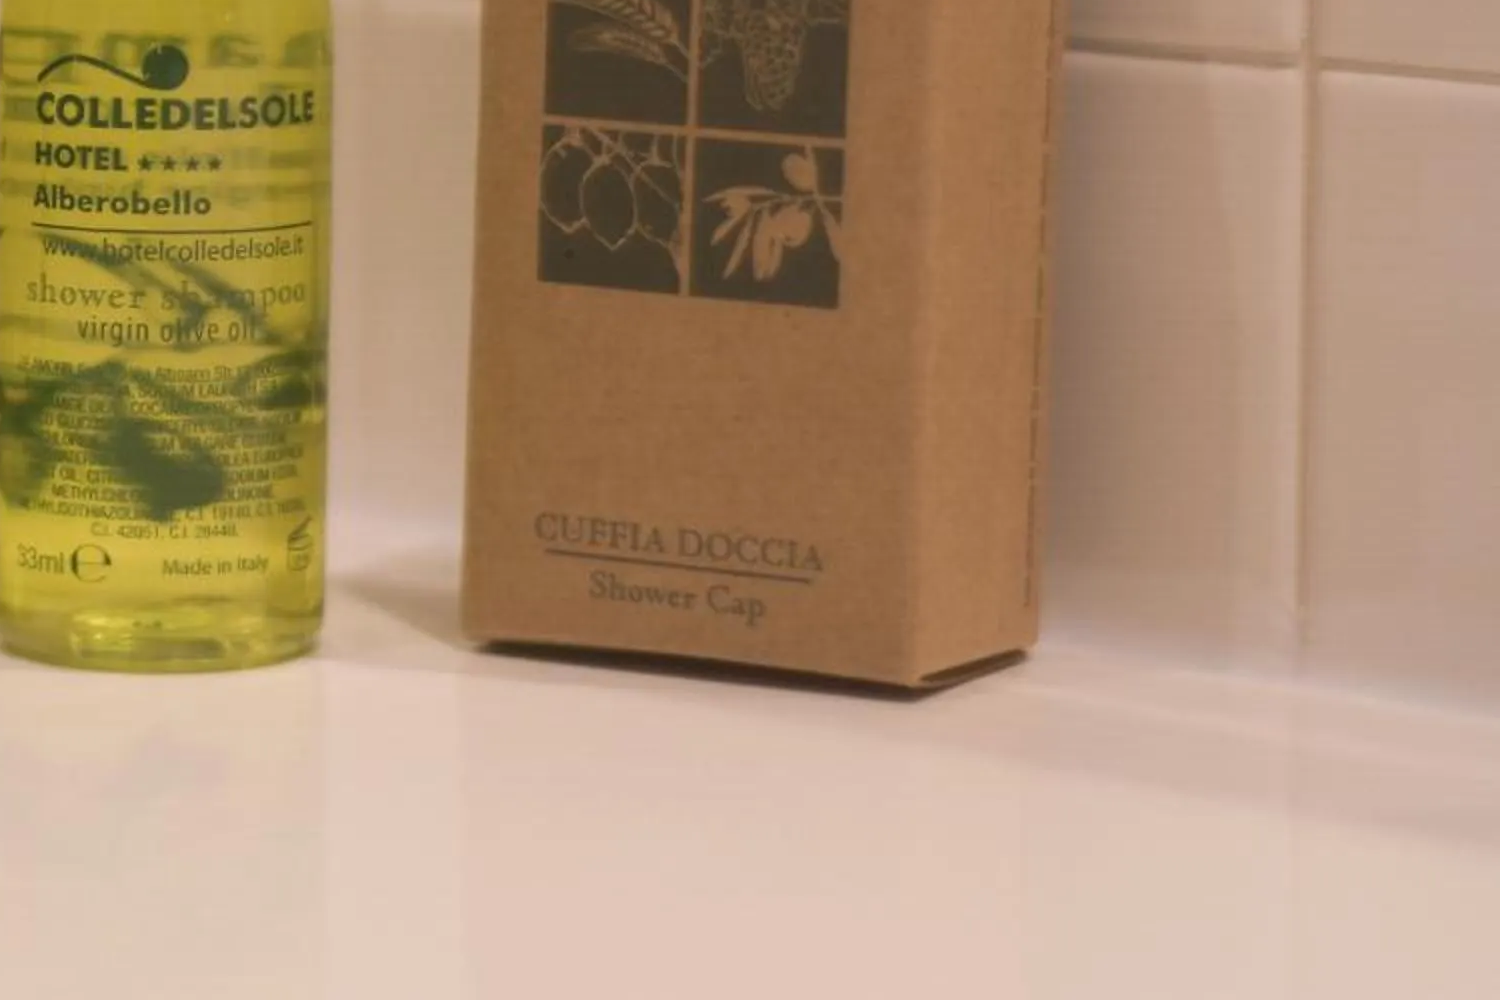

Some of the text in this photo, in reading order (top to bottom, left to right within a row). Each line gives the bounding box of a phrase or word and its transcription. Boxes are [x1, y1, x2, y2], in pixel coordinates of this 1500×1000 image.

[37, 91, 315, 131] COLLEDELSOLE
[35, 141, 128, 171] HOTEL
[33, 183, 211, 215] Alberobello
[43, 232, 303, 263] ww.hotelcolledelsole.it
[27, 272, 146, 310] shower
[77, 314, 257, 348] virgin olive oil
[534, 511, 825, 572] CUFFIA DOCCIA
[17, 543, 64, 574] 33ml
[162, 554, 269, 576] Made in Italy
[589, 569, 767, 629] Shower Cap
